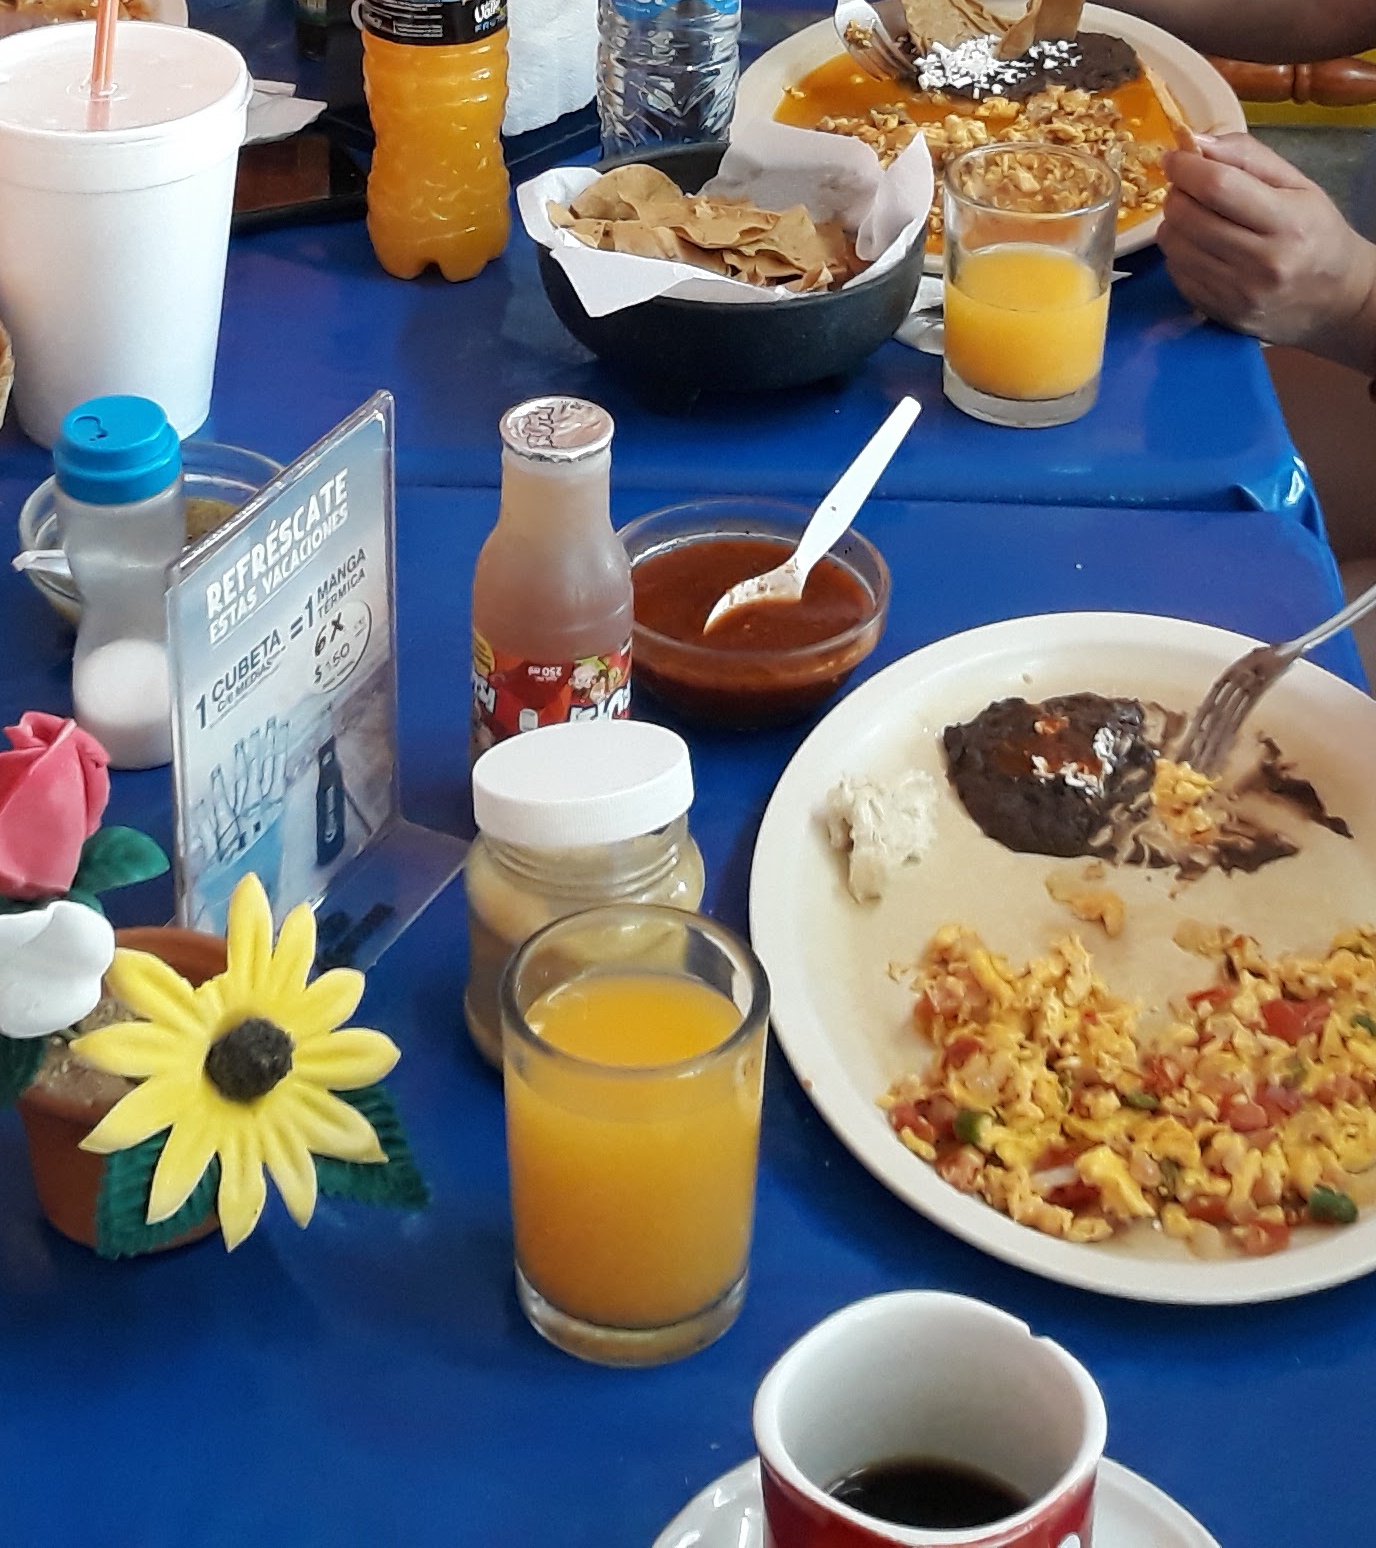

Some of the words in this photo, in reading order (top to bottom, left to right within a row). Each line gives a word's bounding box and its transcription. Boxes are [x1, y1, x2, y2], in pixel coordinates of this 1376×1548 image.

[205, 467, 349, 620] REFRÉSCATE
[208, 589, 258, 645] ESTAS
[261, 502, 349, 595] VACACIONES
[194, 693, 207, 729] 1
[211, 627, 282, 702] CUBETA
[316, 547, 367, 604] MANGA
